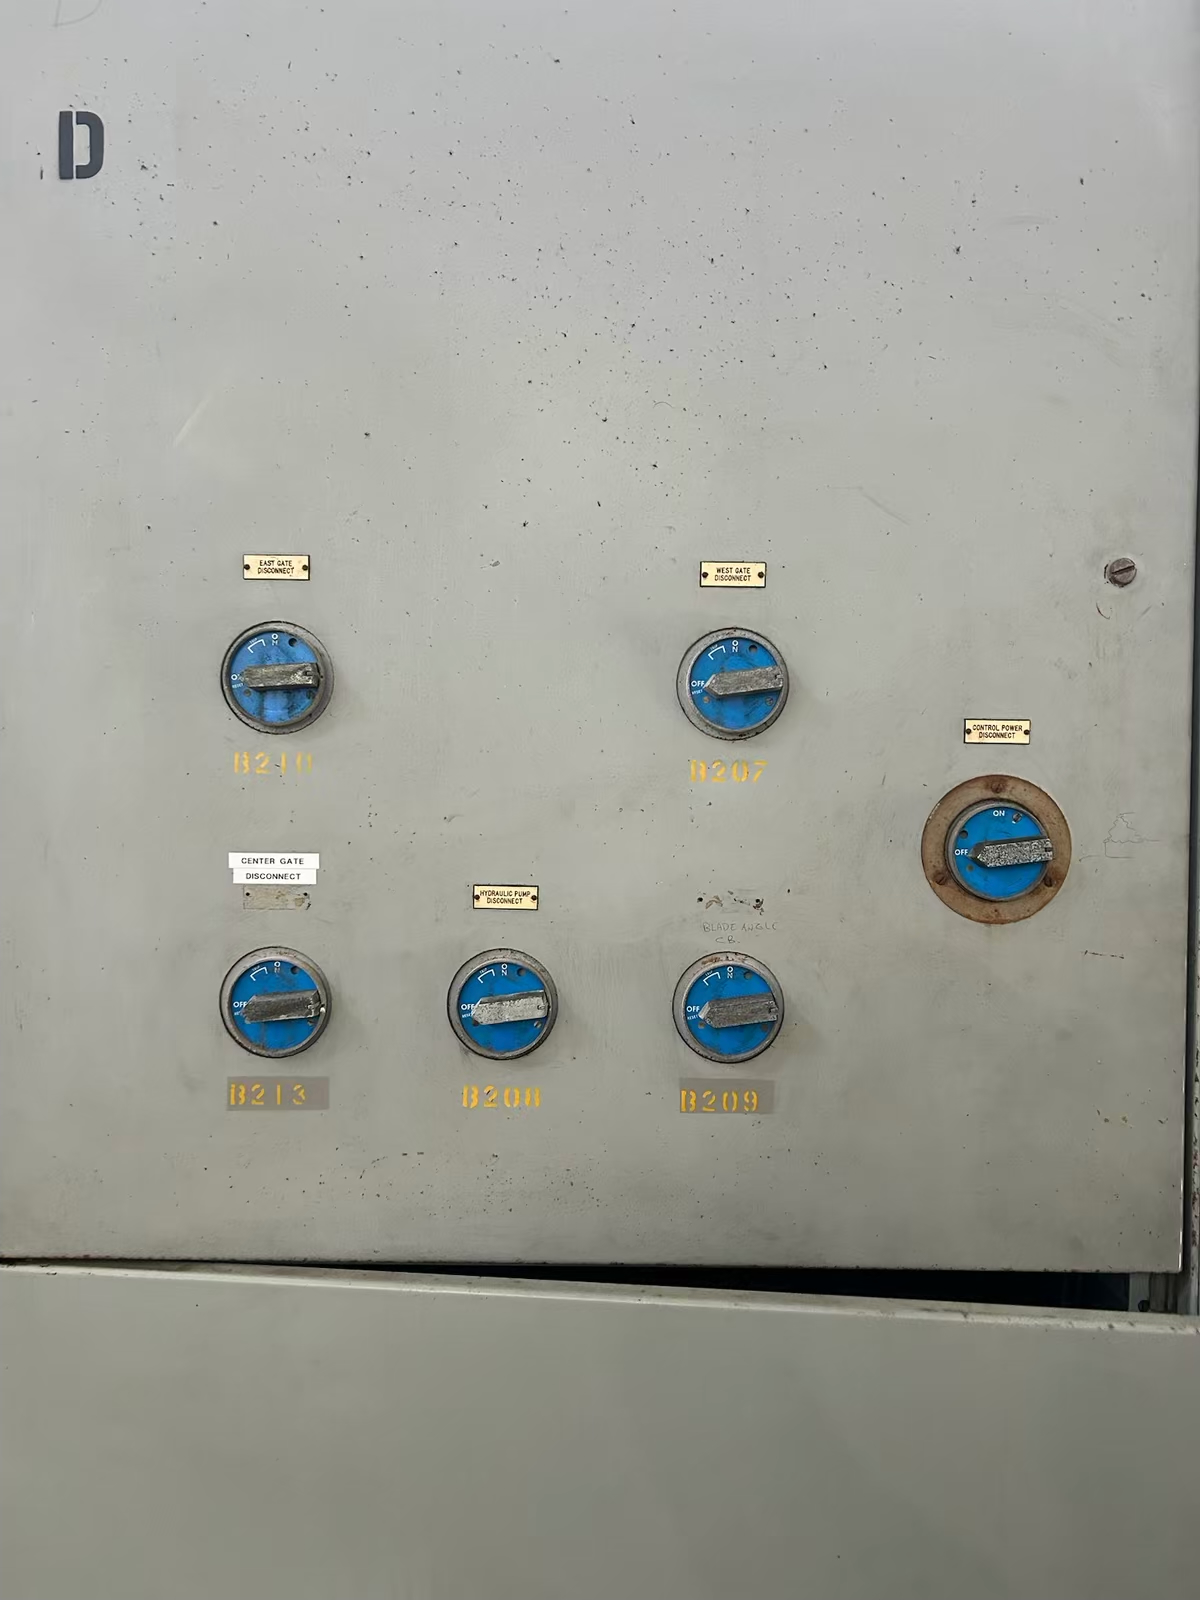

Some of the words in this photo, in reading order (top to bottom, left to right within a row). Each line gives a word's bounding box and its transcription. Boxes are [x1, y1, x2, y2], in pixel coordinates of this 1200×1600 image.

[59, 111, 104, 180] D
[714, 574, 752, 582] DISCONNECT
[731, 639, 739, 653] ON
[690, 680, 705, 688] OFF
[972, 724, 1000, 732] CONTROL
[1001, 724, 1023, 732] POWER
[978, 731, 1016, 739] DISCONNECT
[690, 759, 769, 783] B207
[954, 848, 969, 856] OFF
[241, 857, 275, 865] CENTER
[279, 857, 305, 865] GATE
[245, 872, 302, 881] DISCONNECT
[514, 890, 531, 898] PUMP
[486, 897, 523, 905] DISCONNECT
[702, 921, 737, 933] BLADE
[232, 1001, 247, 1009] OFF
[460, 1003, 475, 1011] OFF
[686, 1005, 700, 1013] OFF
[230, 1083, 306, 1106] B213
[680, 1090, 759, 1113] B209
